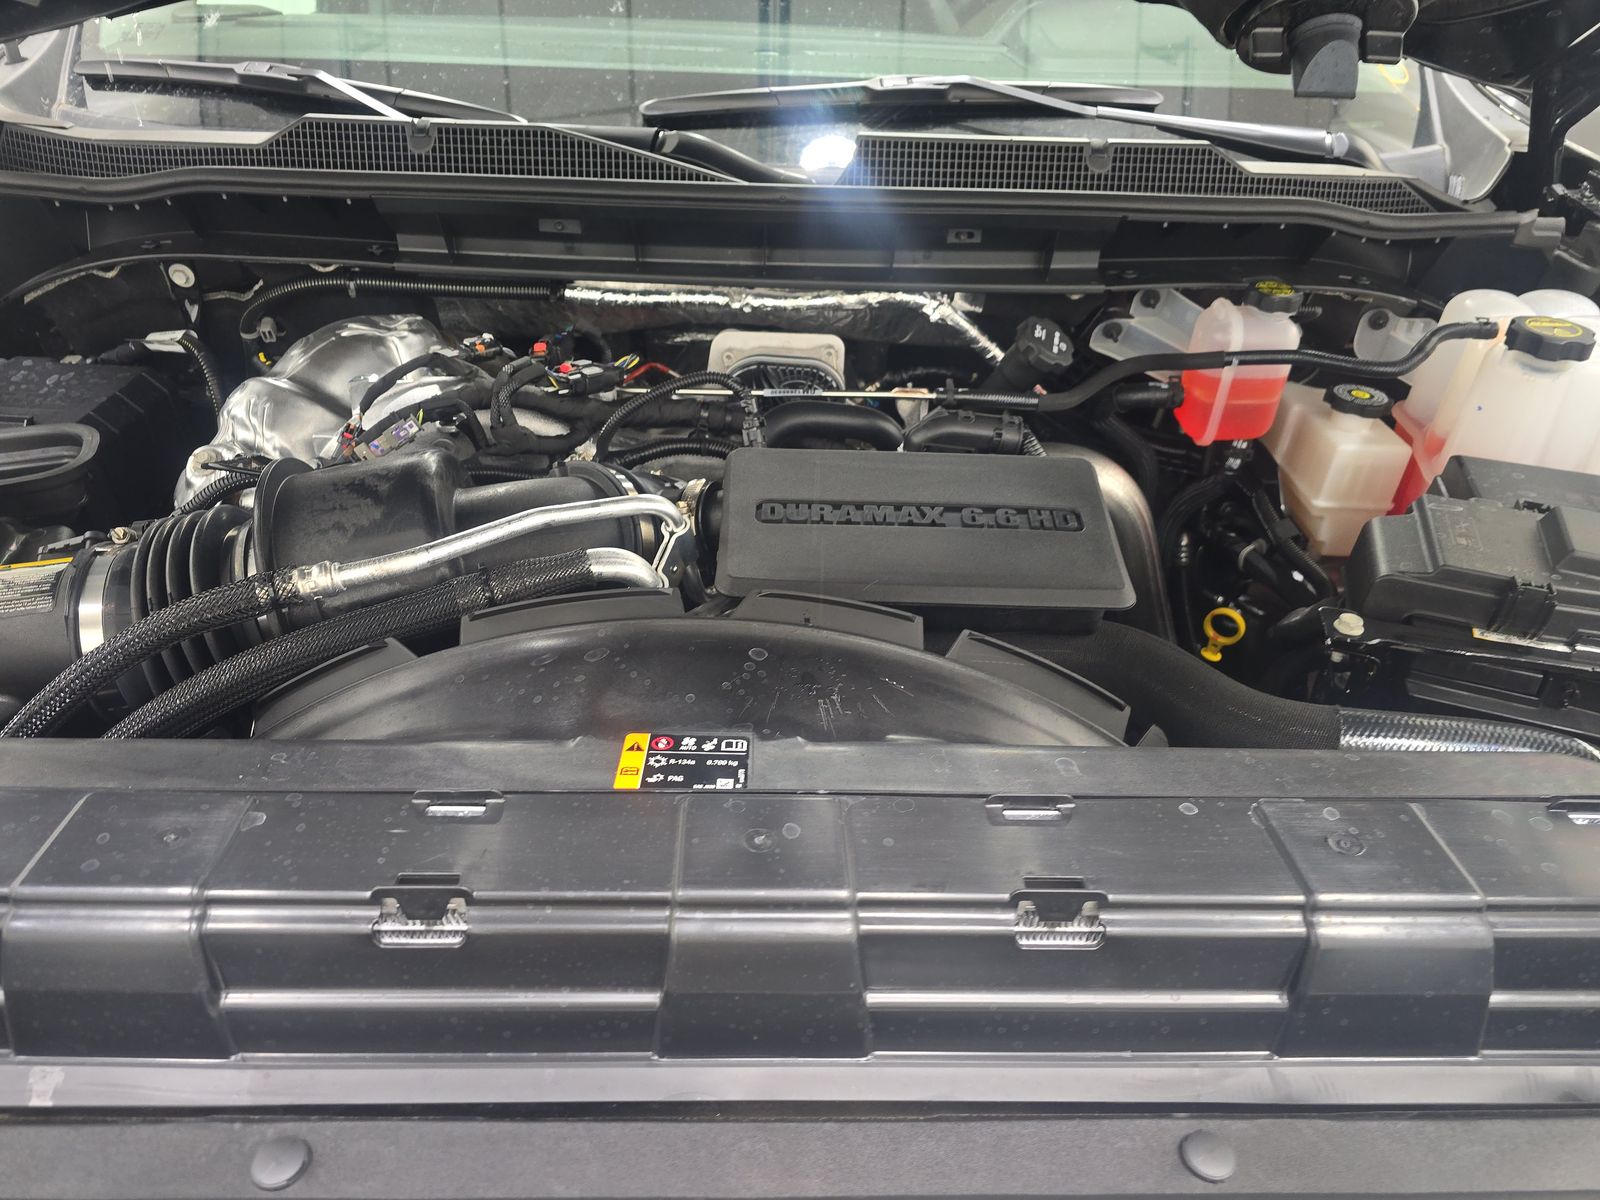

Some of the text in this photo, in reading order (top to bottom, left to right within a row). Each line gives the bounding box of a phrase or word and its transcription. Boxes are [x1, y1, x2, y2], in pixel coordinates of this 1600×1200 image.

[759, 502, 1081, 531] DURAMAX 6.6 HD
[728, 759, 739, 767] kg
